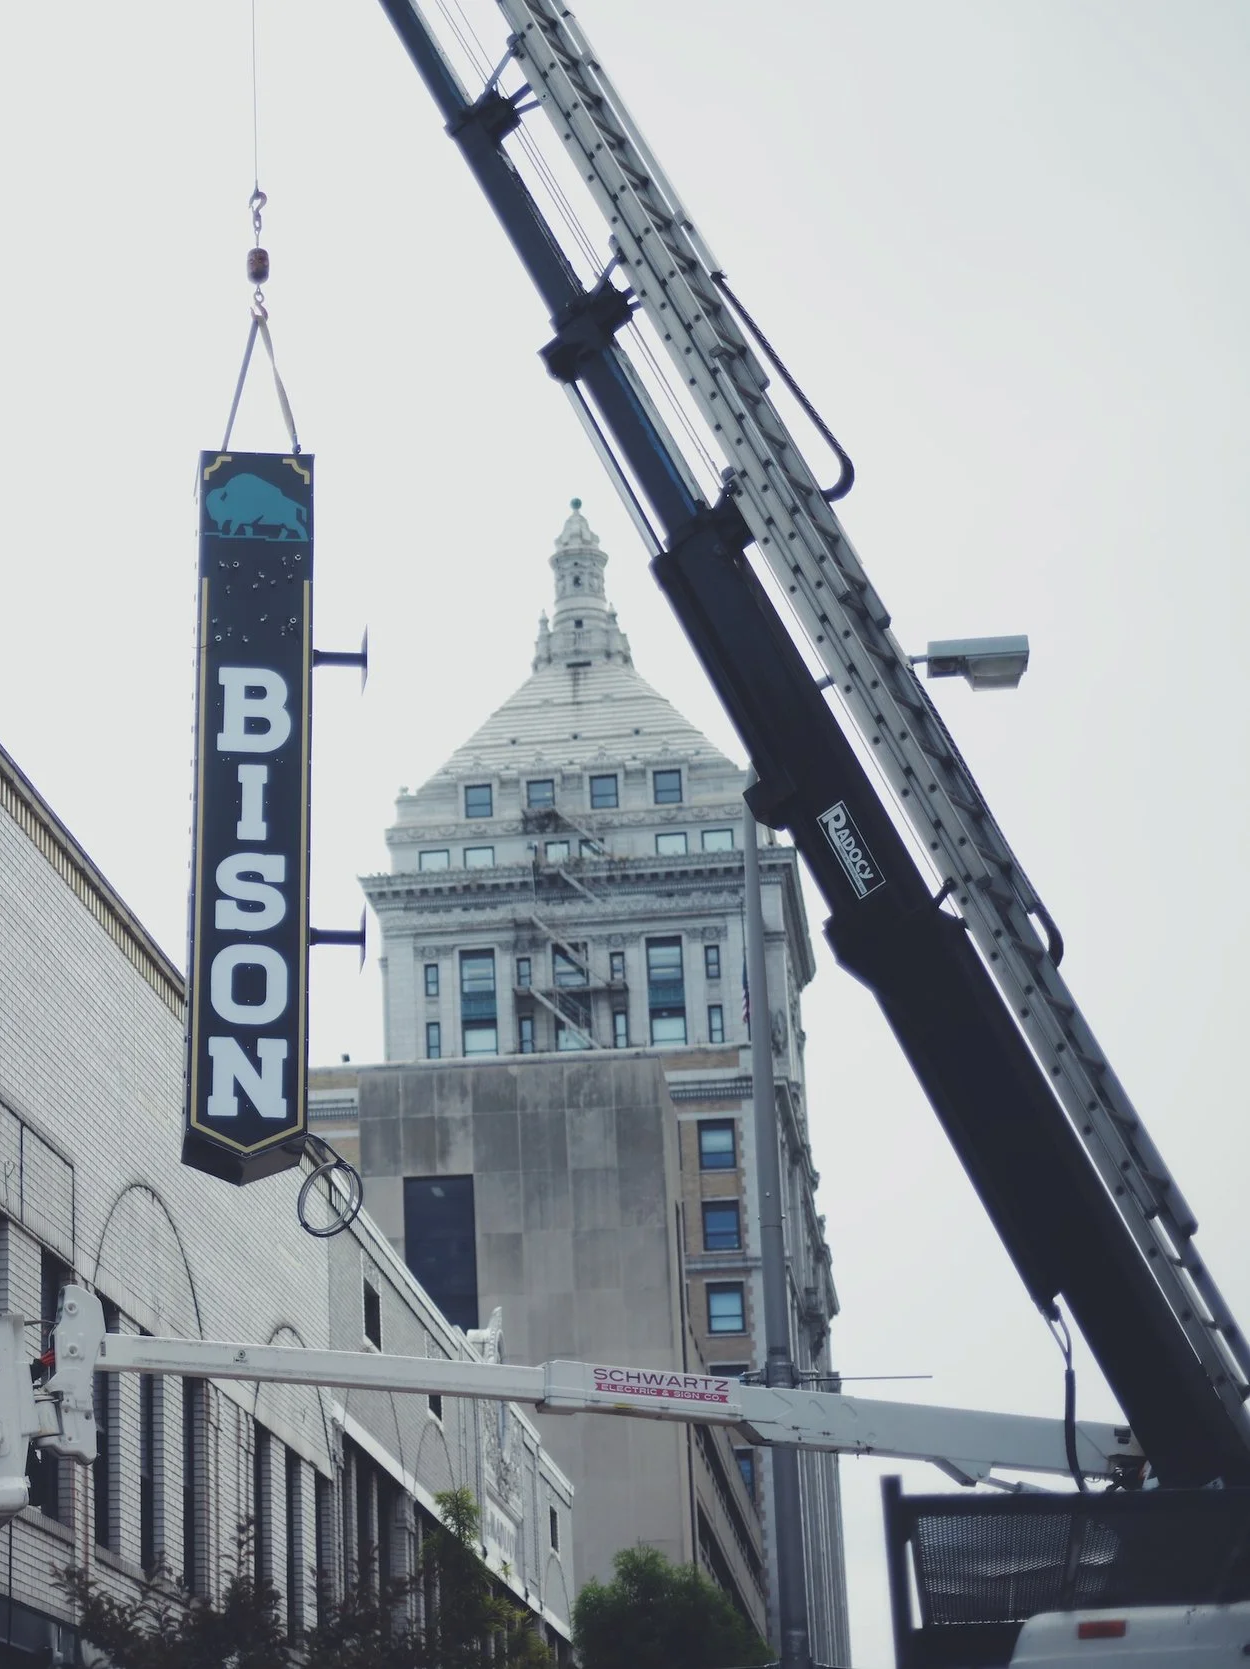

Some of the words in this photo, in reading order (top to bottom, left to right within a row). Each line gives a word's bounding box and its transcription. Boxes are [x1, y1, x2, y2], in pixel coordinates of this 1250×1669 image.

[821, 805, 874, 894] RADOCY
[207, 666, 292, 1119] BISON
[593, 1368, 729, 1392] SCHWARTZ
[601, 1384, 658, 1396] ELECTRIC
[661, 1389, 670, 1397] &
[673, 1390, 700, 1400] SIGN
[704, 1393, 723, 1402] CO.
